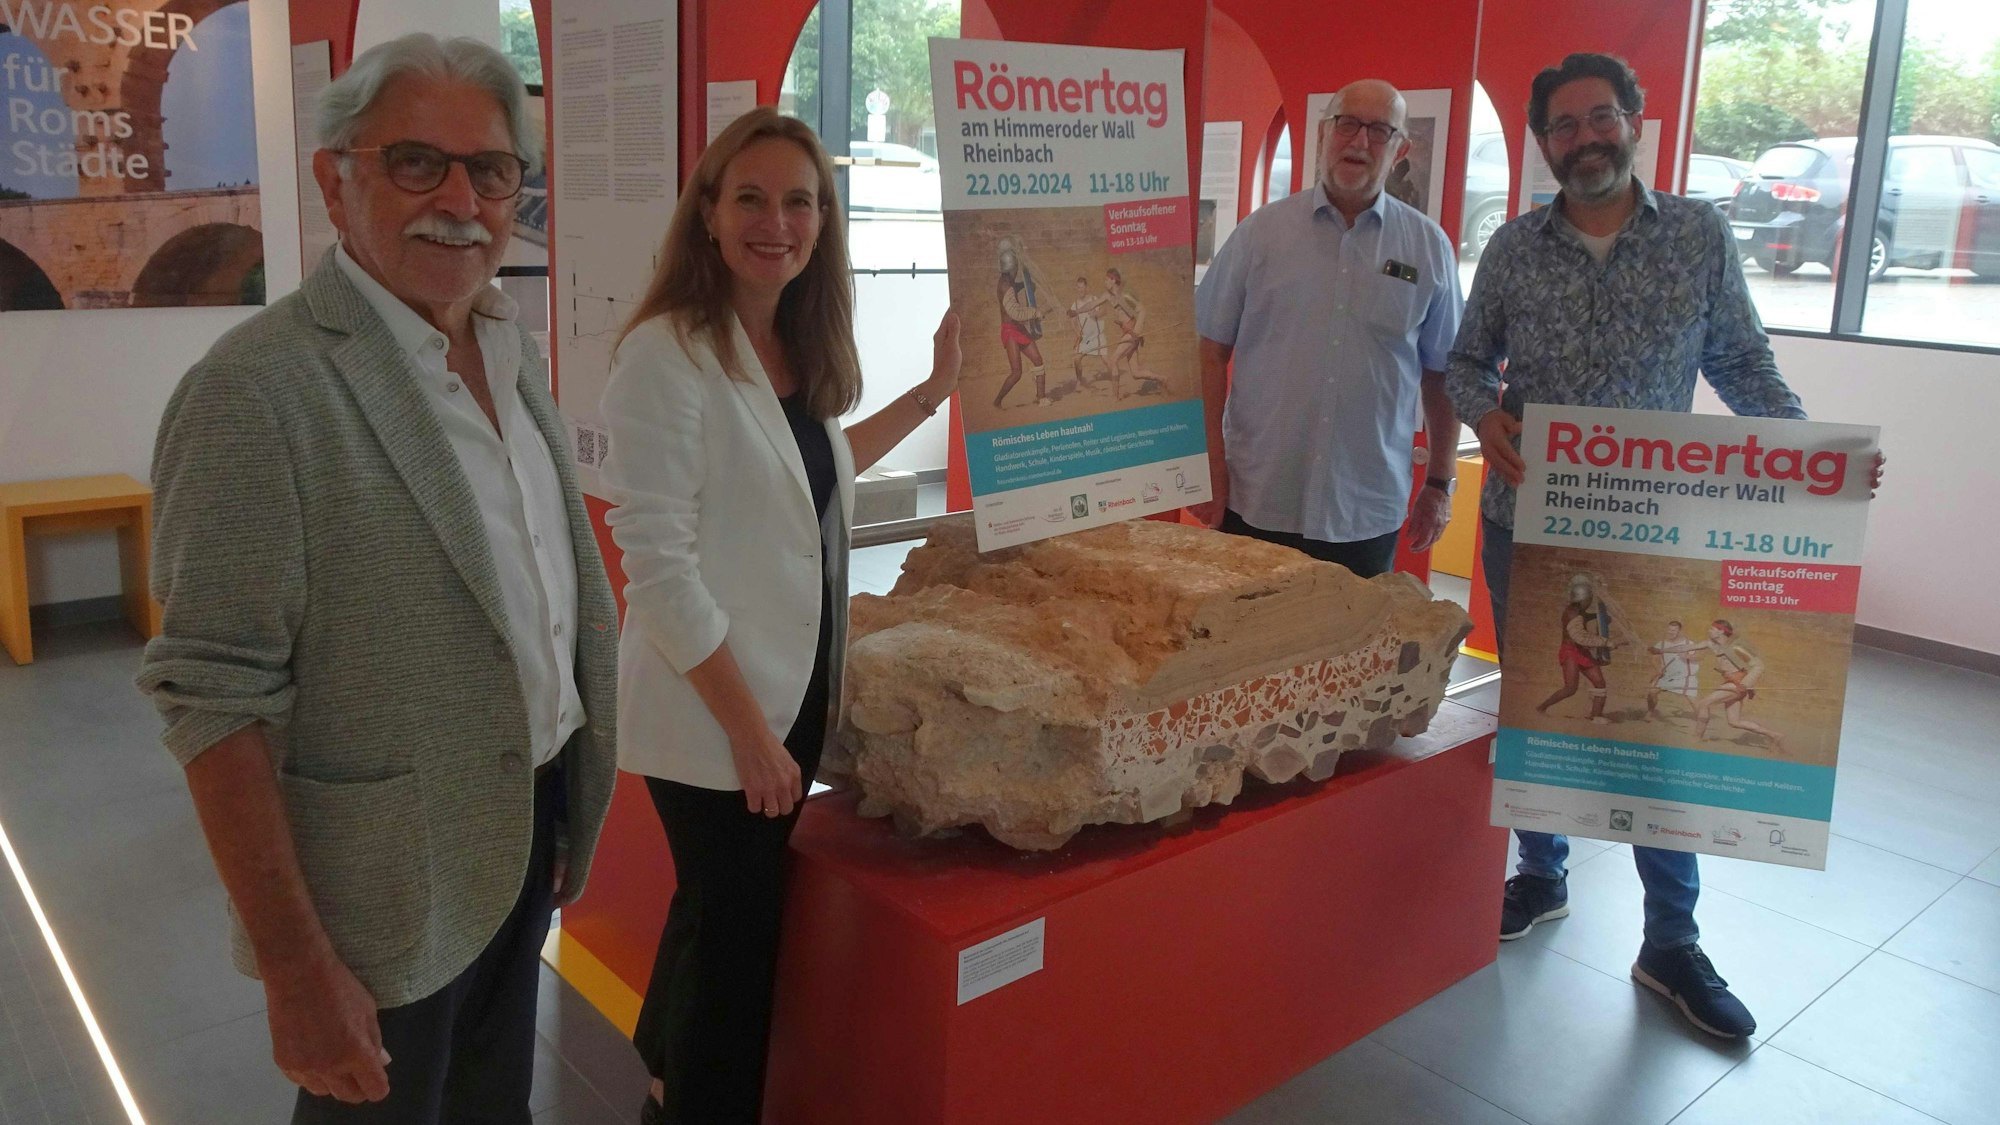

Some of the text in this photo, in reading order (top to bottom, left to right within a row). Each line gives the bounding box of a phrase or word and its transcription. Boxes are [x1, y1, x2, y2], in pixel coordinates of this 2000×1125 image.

[1, 0, 198, 51] WASSER
[3, 53, 69, 93] für
[954, 60, 1168, 129] Römertag
[9, 98, 134, 138] Roms
[961, 118, 1136, 140] am Himmeroder Wall
[12, 140, 149, 180] Städte
[964, 143, 1054, 164] Rheinbach
[966, 171, 1170, 196] 22.09.2024 11-18 Uhr
[1109, 204, 1176, 221] Verkaufsoffener
[1110, 221, 1147, 235] Sonntag
[1112, 235, 1158, 248] von 13-18 Uhr
[992, 422, 1094, 448] Römisches Leben hautnah!
[1100, 436, 1111, 444] und
[1546, 422, 1848, 496] Römertag
[1547, 472, 1785, 504] am Himmeroder Wall
[1107, 497, 1137, 509] Rheinbach
[1545, 490, 1659, 516] Rheinbach
[1543, 515, 1833, 559] 22.09.2024 11-18 Uhr
[1728, 565, 1839, 582] Verkaufsoffener
[1727, 579, 1784, 594] Sonntag
[1727, 594, 1800, 606] von 13-18 Uhr
[1527, 736, 1659, 761] Römisches Leben hautnah!
[1757, 780, 1773, 789] und
[1660, 827, 1702, 839] Rheinbach
